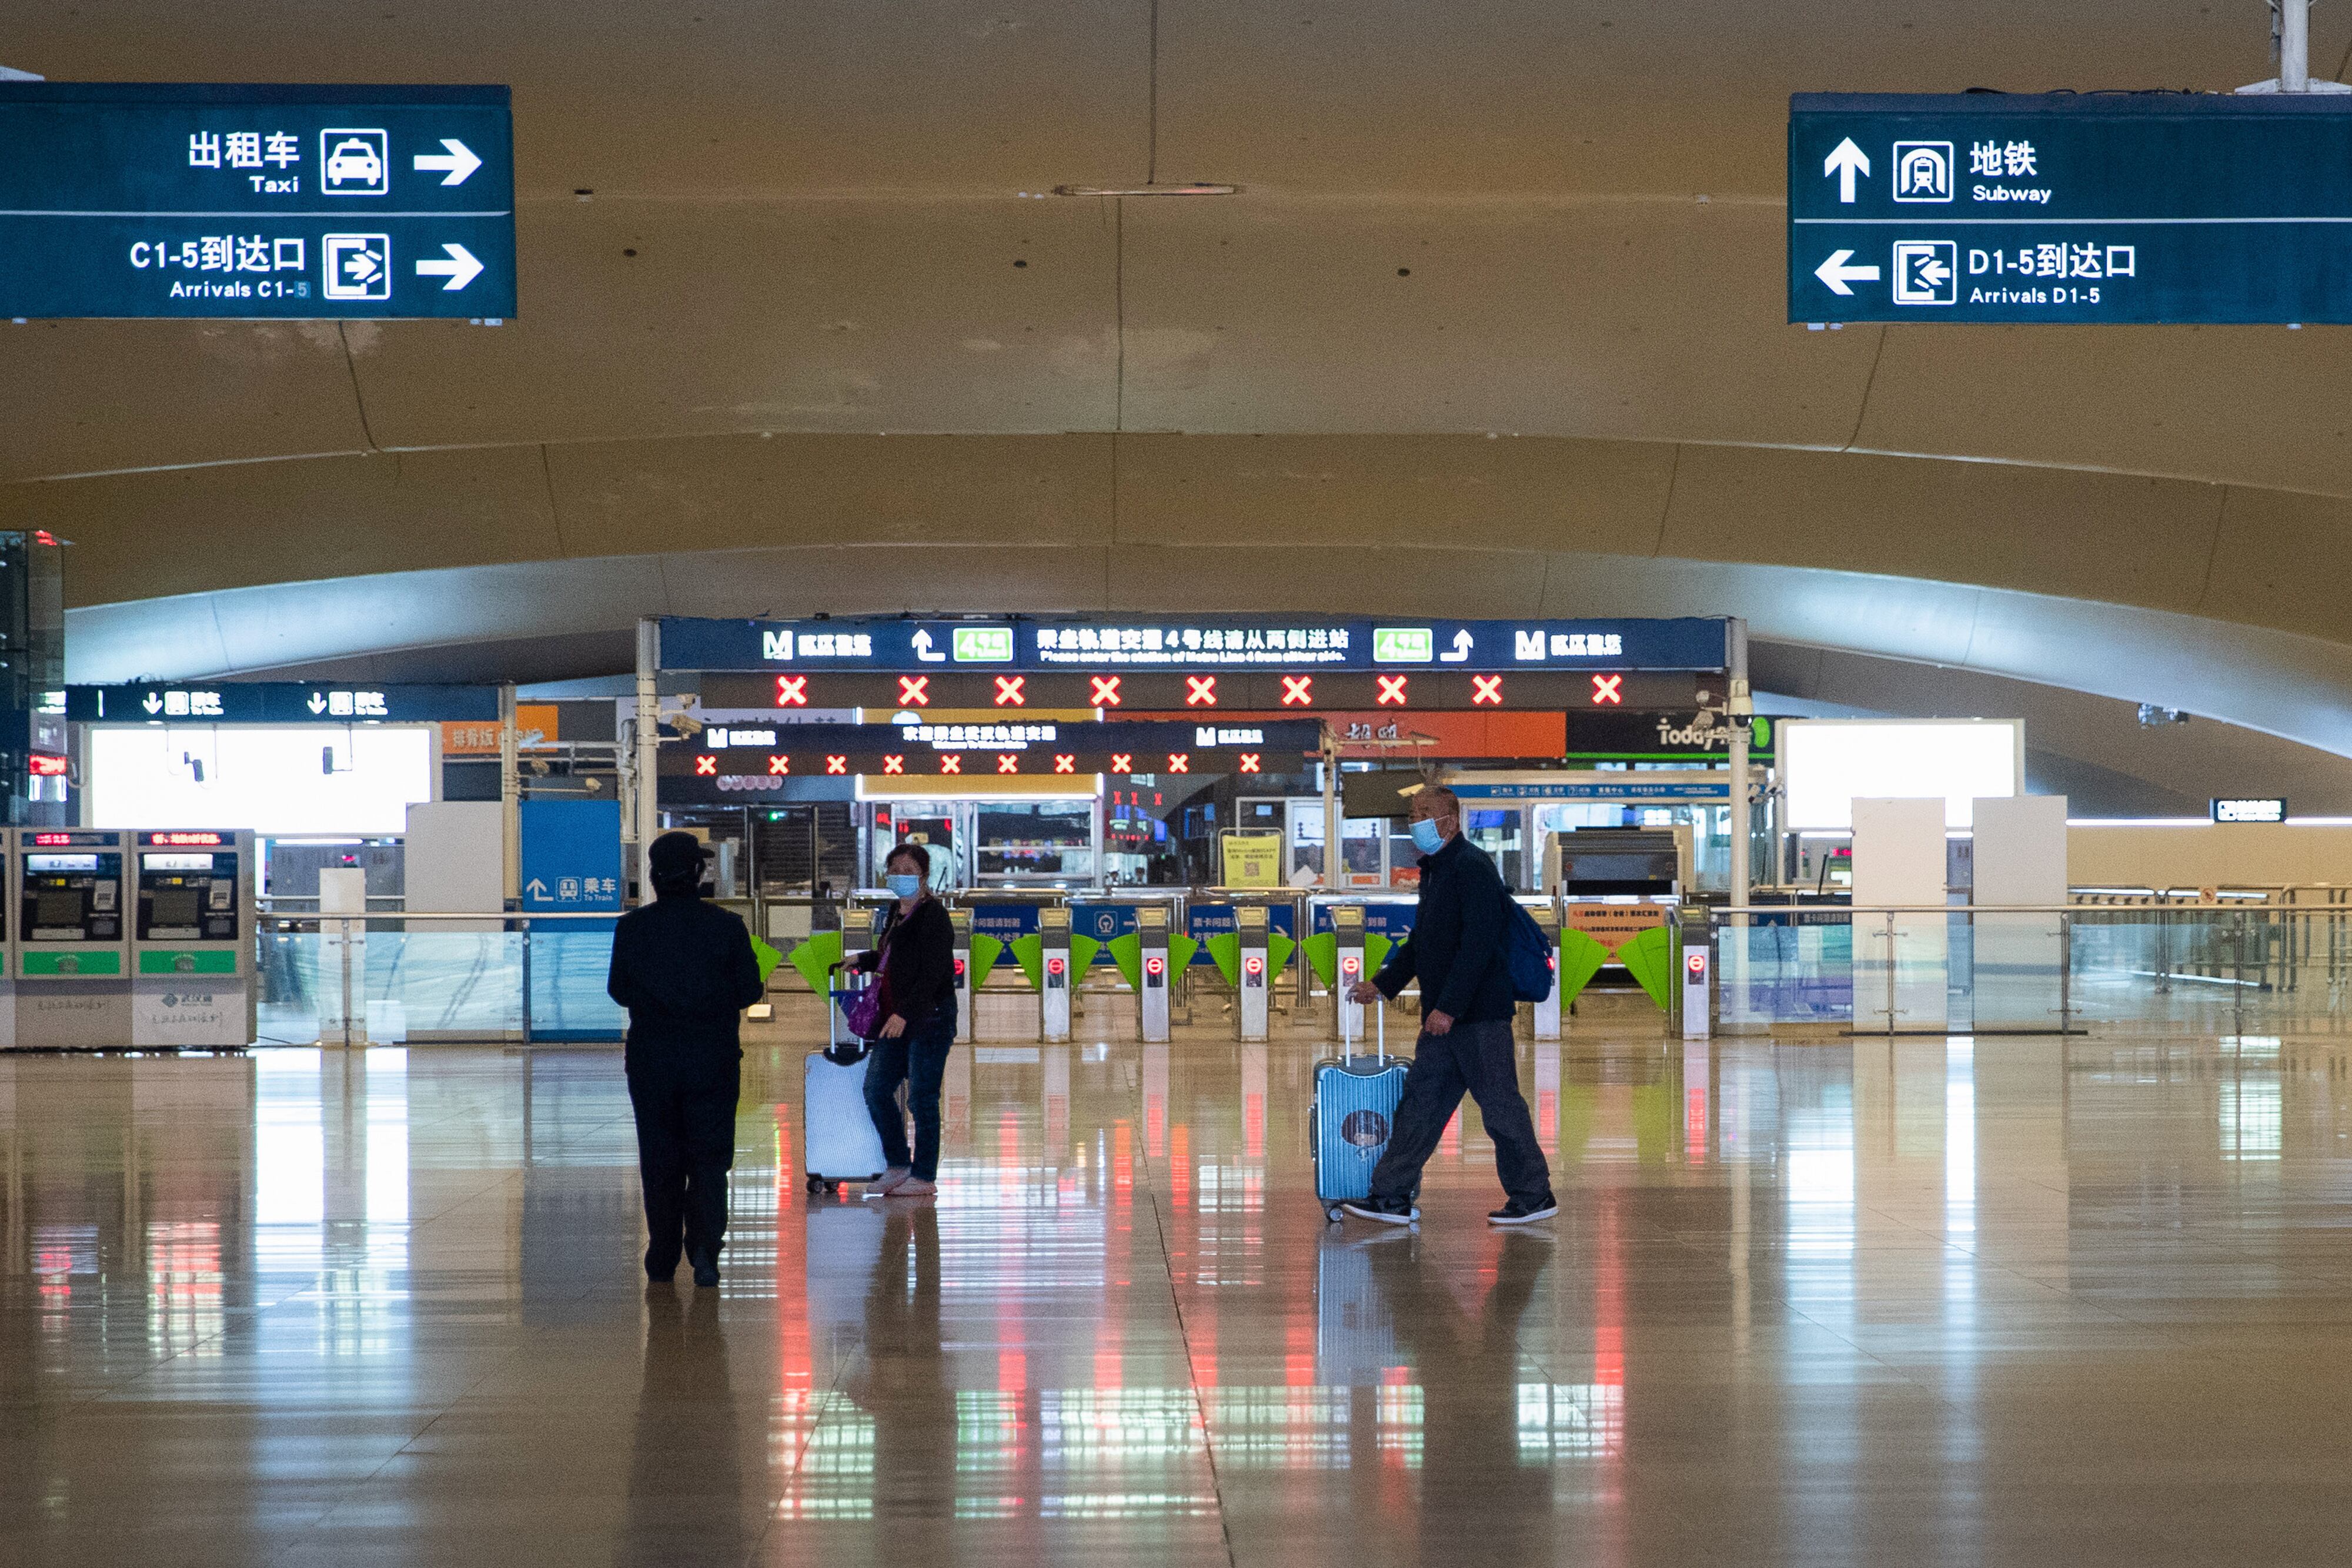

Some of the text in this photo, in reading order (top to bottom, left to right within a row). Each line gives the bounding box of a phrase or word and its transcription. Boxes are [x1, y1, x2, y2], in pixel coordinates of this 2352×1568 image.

[189, 131, 300, 169] 出租车
[1970, 140, 2037, 177] 地铁
[249, 176, 299, 193] Taxi
[1973, 185, 2052, 204] Subway
[130, 235, 305, 272] C1-5到达口
[1969, 242, 2135, 279] D1-5到达口
[170, 280, 308, 298] Arrivals C1-5
[1970, 287, 2100, 304] Arrivals D1-5
[1040, 651, 1079, 663] Please
[584, 878, 616, 893] 乘车
[1193, 917, 1234, 927] 票卡问题
